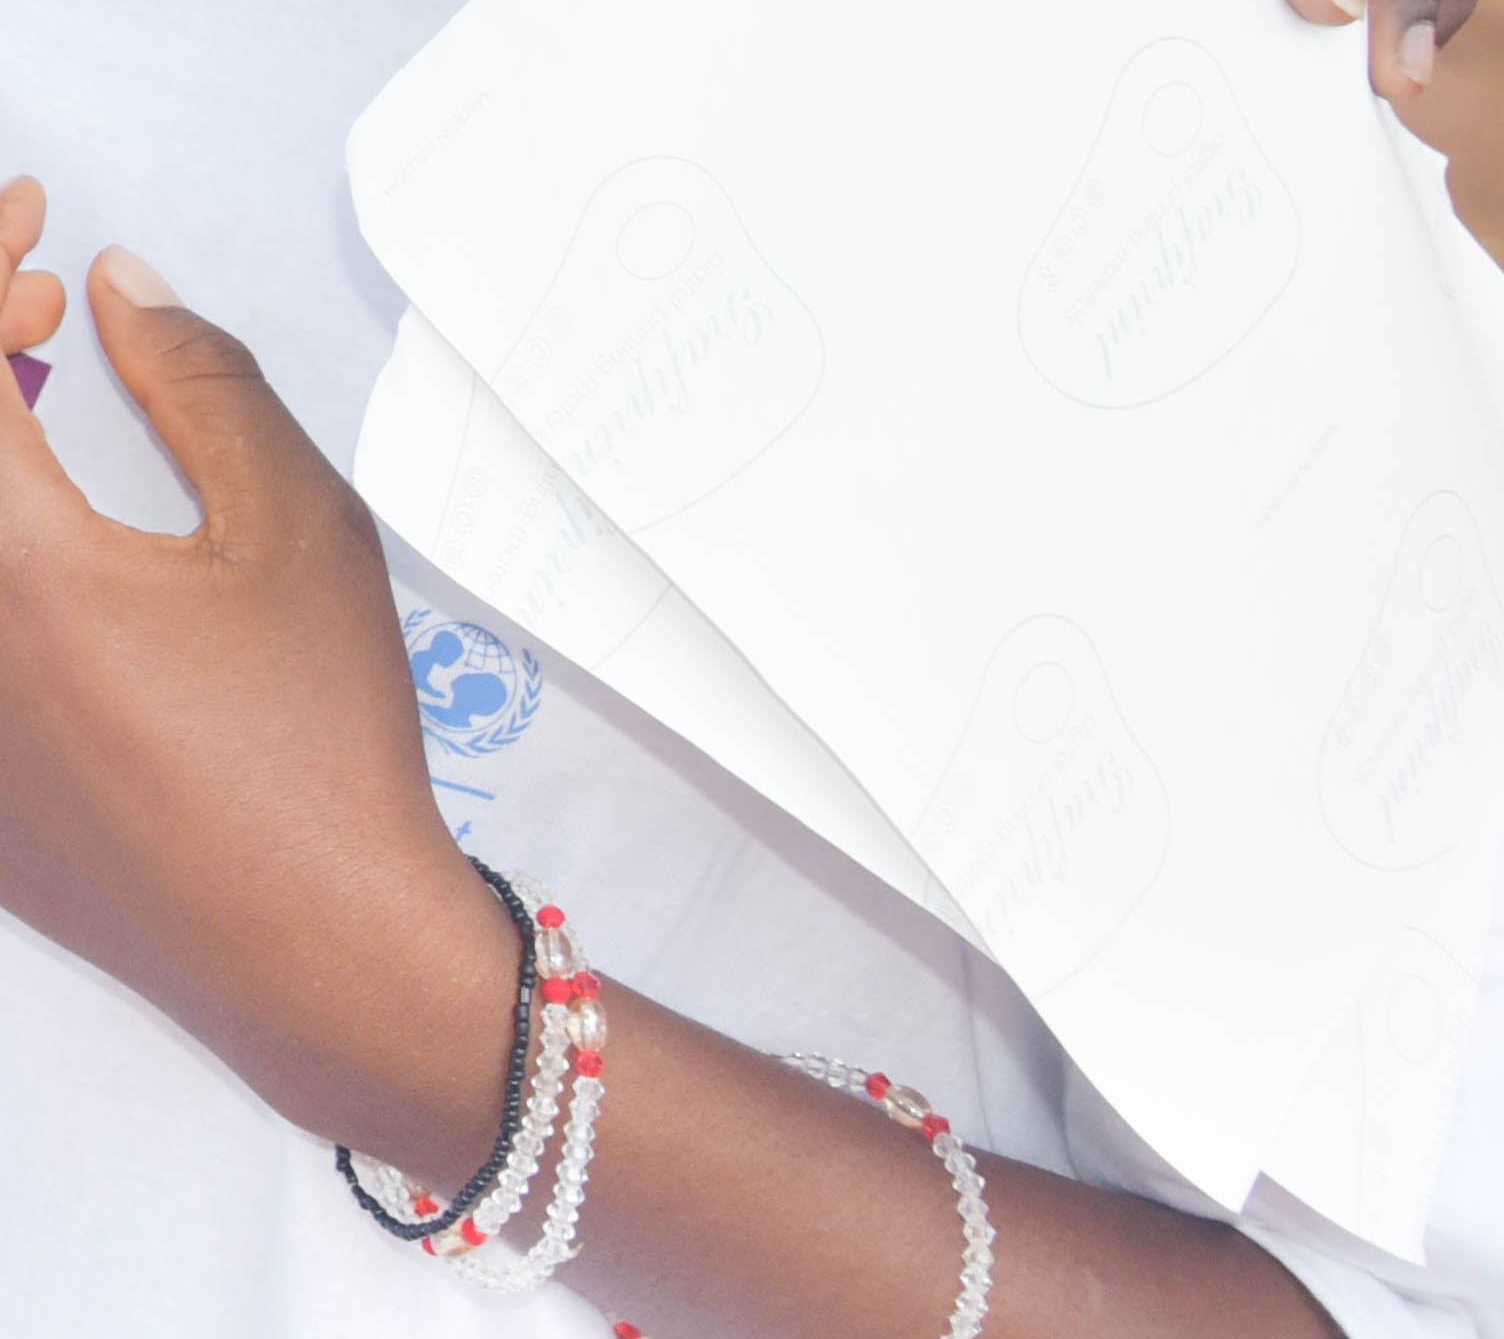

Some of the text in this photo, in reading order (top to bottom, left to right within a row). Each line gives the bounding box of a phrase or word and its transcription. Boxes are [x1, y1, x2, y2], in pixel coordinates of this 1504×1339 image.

[1127, 179, 1181, 247] printing
[668, 250, 725, 310] digital
[1063, 246, 1129, 326] materials
[1095, 167, 1263, 383] Grafiprint
[594, 303, 668, 376] printing
[572, 288, 769, 468] Grafiprin
